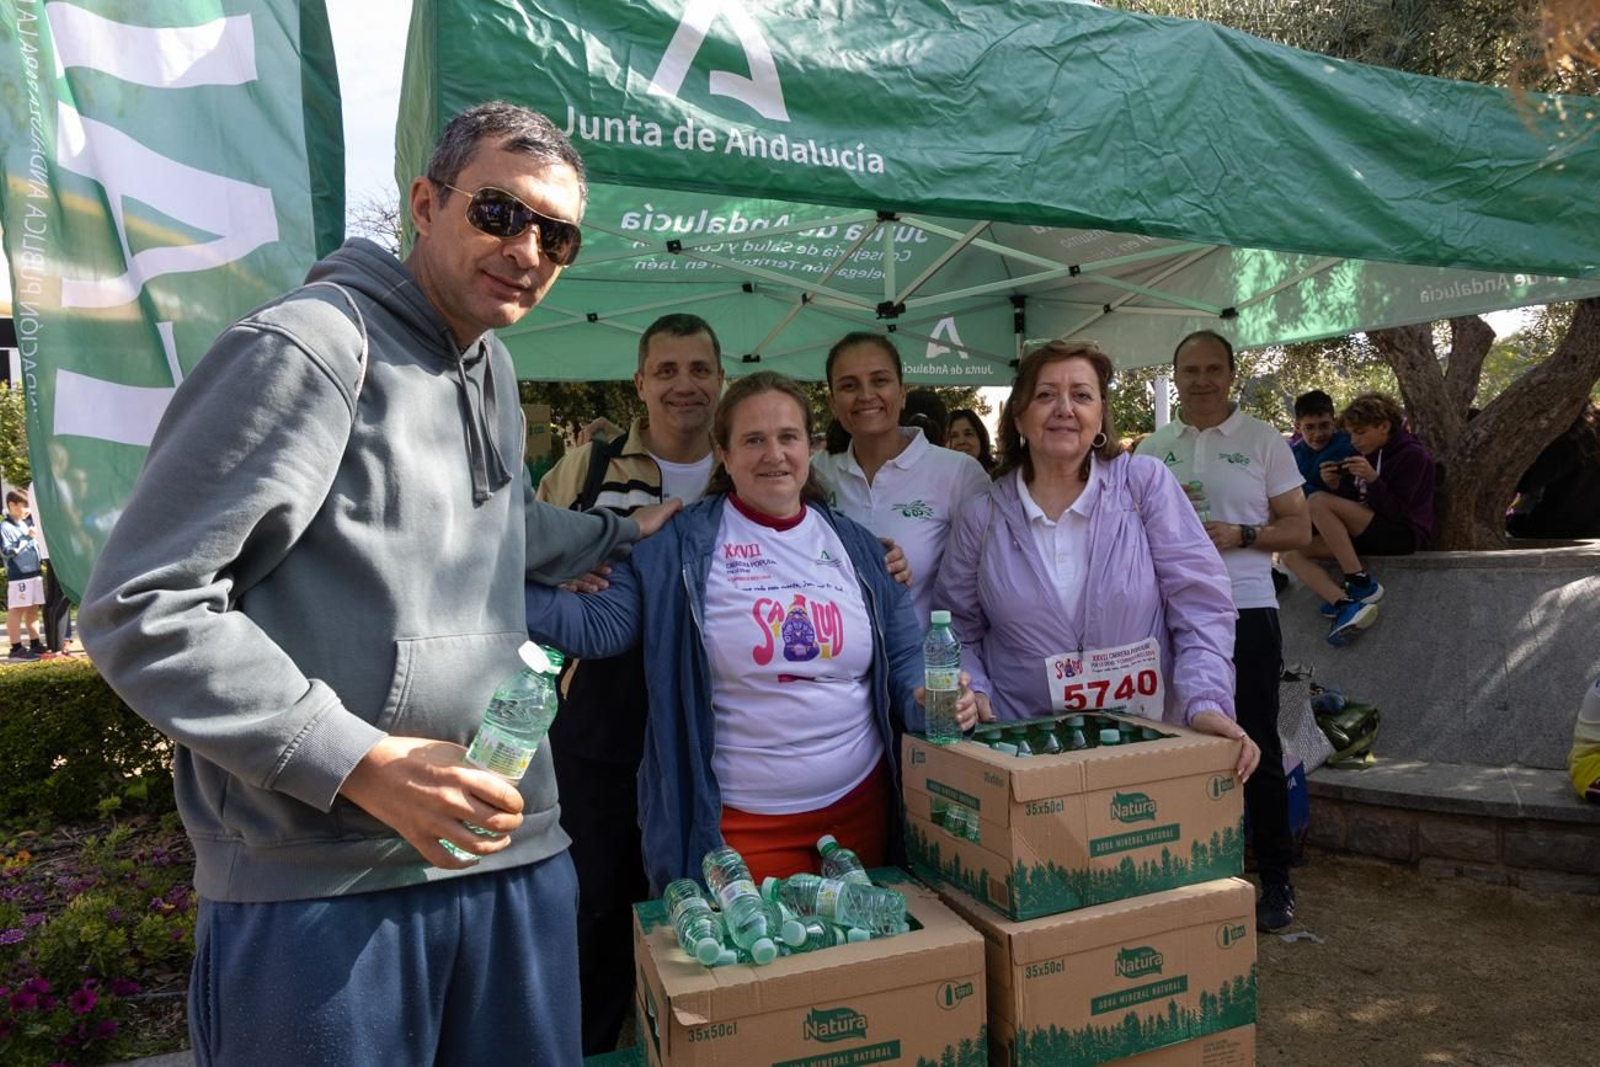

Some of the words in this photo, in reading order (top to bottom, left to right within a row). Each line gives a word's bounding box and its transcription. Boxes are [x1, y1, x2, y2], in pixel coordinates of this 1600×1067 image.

[562, 105, 662, 147] Junta
[673, 118, 716, 153] de
[724, 126, 885, 175] Andalucía
[1063, 669, 1158, 710] 5740
[1025, 799, 1065, 817] 35x50cl
[1110, 800, 1157, 821] Natura
[1145, 828, 1174, 842] NATURAL
[1025, 959, 1065, 979] 35x50cl
[1115, 950, 1164, 977] Natura
[688, 1022, 738, 1044] 35x50cl
[803, 1014, 868, 1040] Natura
[853, 1045, 892, 1064] NATURAL
